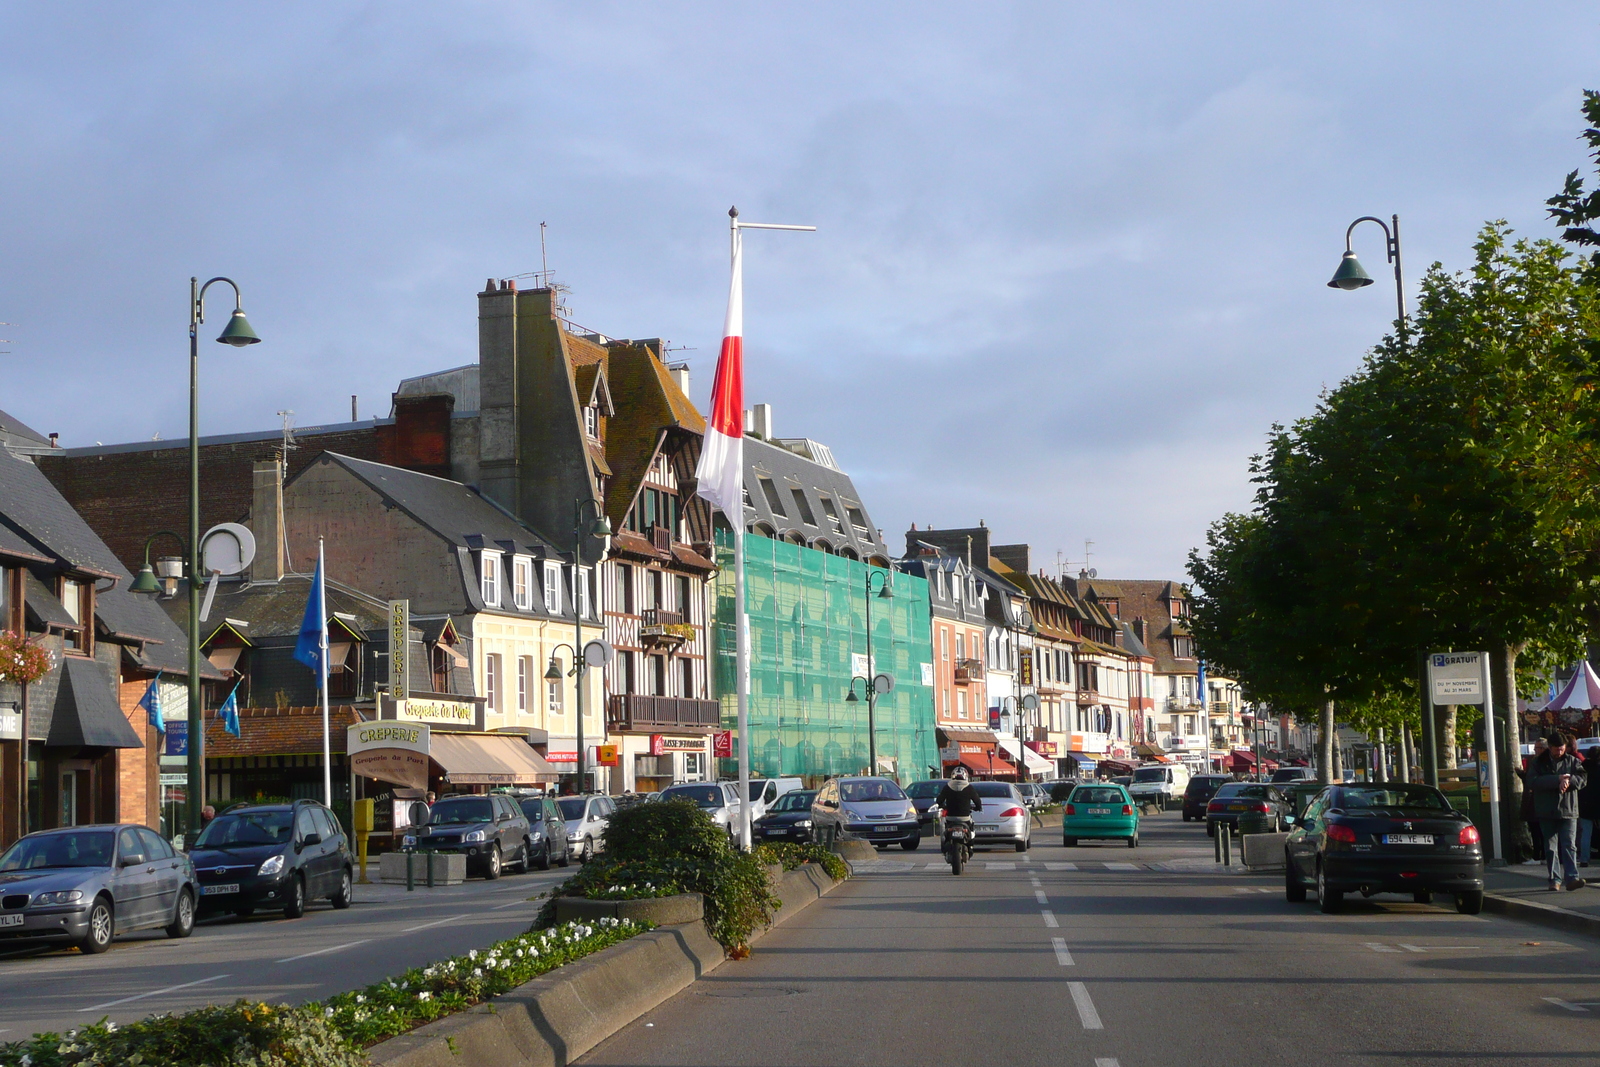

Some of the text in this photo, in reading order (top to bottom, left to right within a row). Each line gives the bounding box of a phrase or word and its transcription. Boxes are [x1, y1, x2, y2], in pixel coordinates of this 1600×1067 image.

[393, 603, 404, 698] CREPERIE
[1445, 656, 1478, 664] GRATUIT
[360, 728, 419, 743] CREPERIE
[1389, 835, 1432, 843] 594 YE 14
[12, 915, 22, 924] 14
